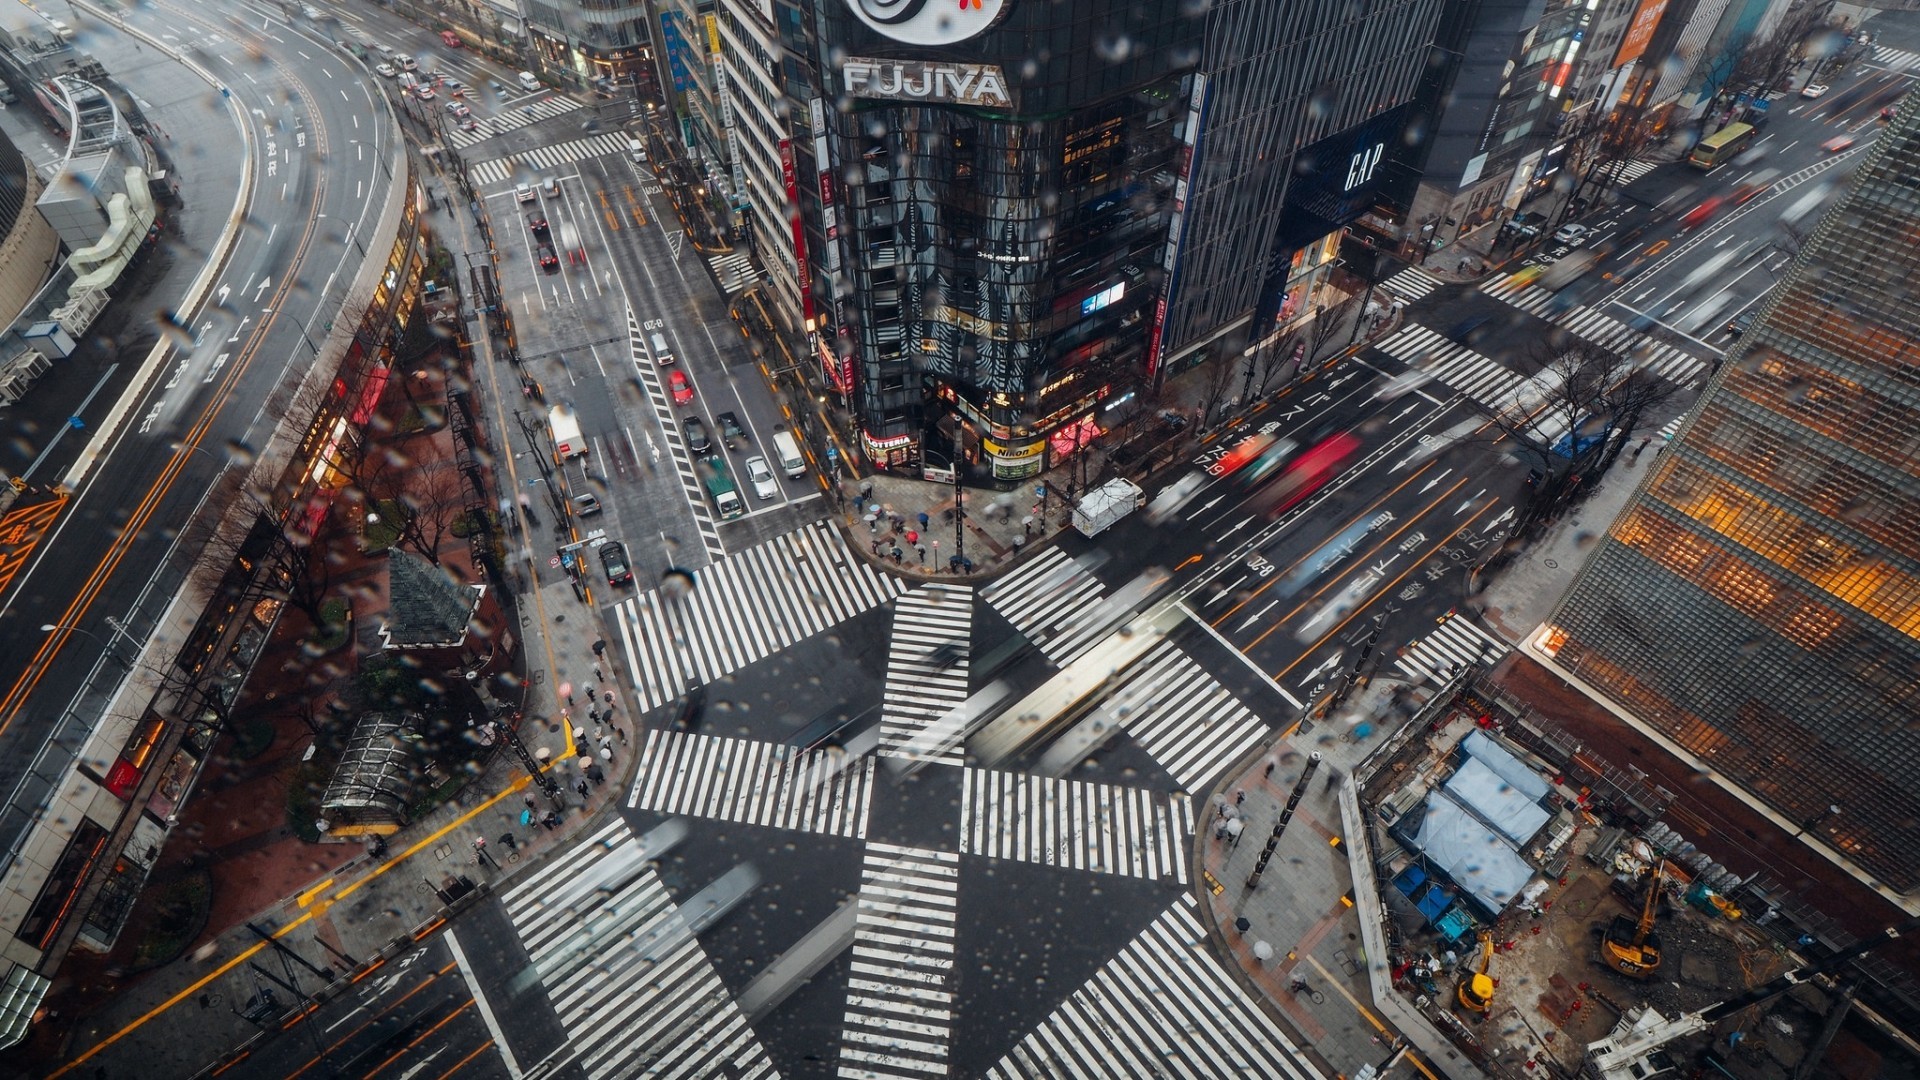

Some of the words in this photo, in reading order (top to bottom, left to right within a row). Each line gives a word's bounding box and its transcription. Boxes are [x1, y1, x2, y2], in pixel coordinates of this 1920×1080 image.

[843, 63, 1007, 103] FUJIYA
[294, 116, 306, 148] 上野
[264, 124, 278, 177] 北池袋
[1344, 142, 1384, 192] GAP
[643, 318, 664, 331] 8-20
[203, 315, 249, 384] 上野
[139, 320, 212, 434] 北池袋
[867, 436, 911, 449] LOTTERIA
[1192, 454, 1226, 476] 17-19
[1456, 527, 1490, 552] 17-19
[1246, 554, 1276, 578] 8-20
